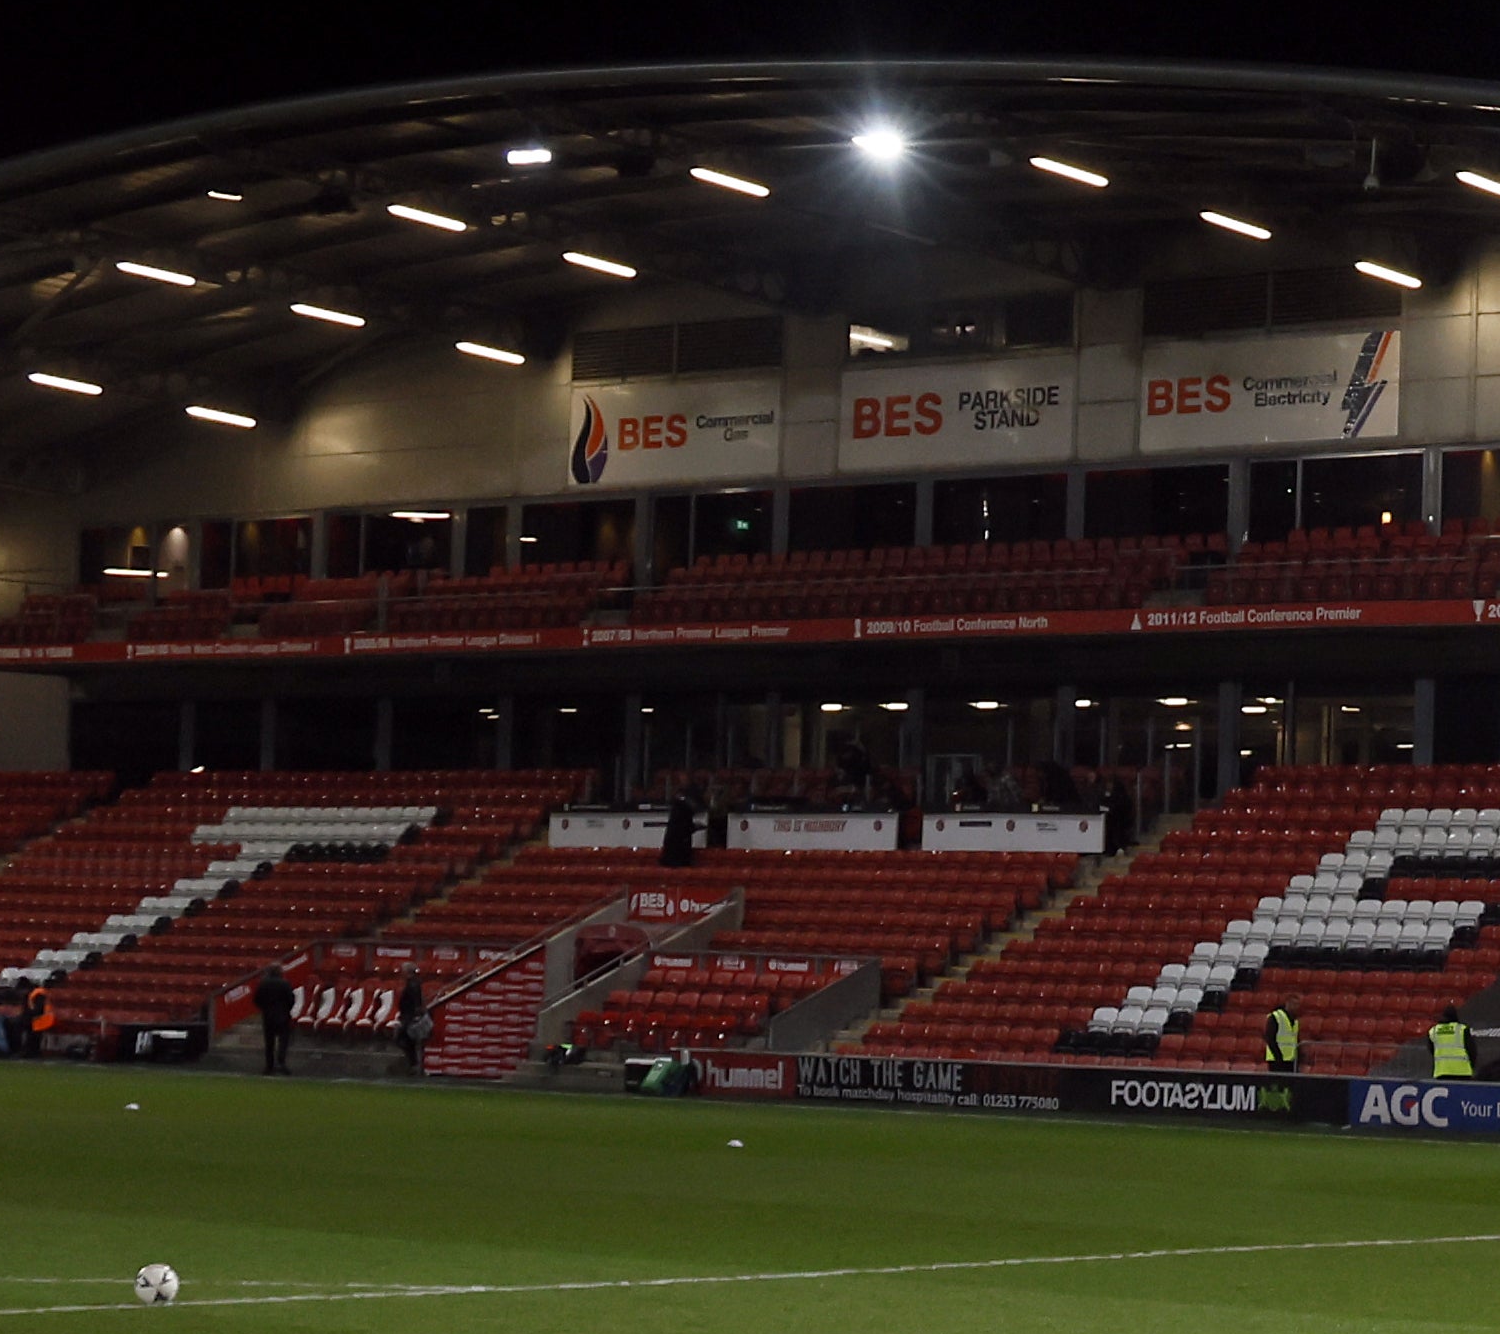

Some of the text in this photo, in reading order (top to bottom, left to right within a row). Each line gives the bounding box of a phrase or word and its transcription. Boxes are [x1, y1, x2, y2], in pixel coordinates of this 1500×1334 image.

[1243, 369, 1338, 391] Commercial
[958, 386, 1060, 411] PARKSIDE
[1148, 374, 1231, 415] BES
[1254, 389, 1331, 407] Electricity
[696, 411, 774, 429] Commercial
[853, 393, 943, 438] BES
[974, 409, 1040, 430] STAND
[618, 413, 688, 450] BES
[724, 428, 749, 442] Gas
[913, 617, 954, 632] Football
[956, 616, 1017, 631] Conference
[1018, 615, 1048, 628] North
[1147, 605, 1362, 626] 2011/12 Football Conference Premier
[706, 1058, 784, 1090] hummel
[797, 1056, 861, 1086] WATCH
[869, 1059, 905, 1088] THE
[912, 1062, 964, 1092] GAME
[797, 1084, 811, 1096] To
[813, 1084, 839, 1097] book
[841, 1087, 895, 1101] matchday
[897, 1089, 955, 1107] hospitality
[982, 1094, 1017, 1109] 01253
[1110, 1079, 1256, 1111] FOOTASYLUM
[1359, 1084, 1449, 1128] AGC
[1461, 1100, 1493, 1118] Your
